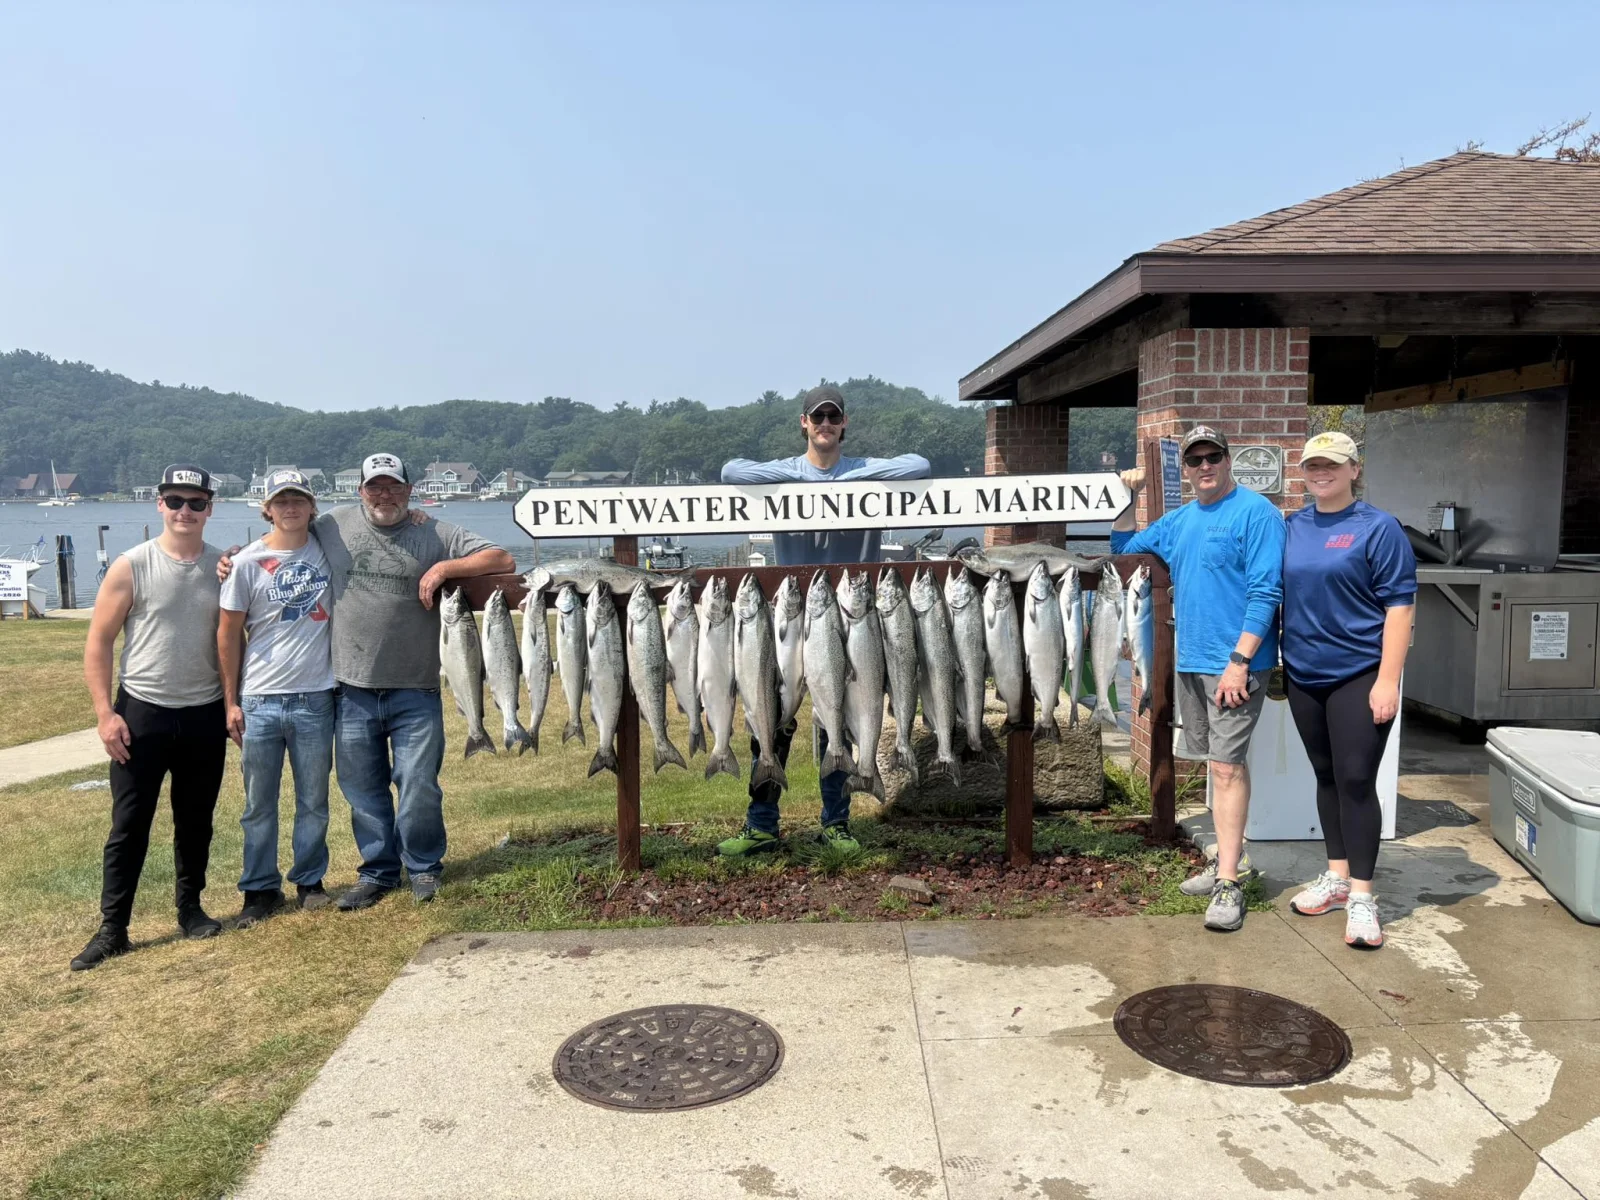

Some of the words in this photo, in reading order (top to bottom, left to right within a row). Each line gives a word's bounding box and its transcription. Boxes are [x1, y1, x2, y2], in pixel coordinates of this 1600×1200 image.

[1238, 477, 1270, 485] CMI
[532, 495, 750, 526] PENTWATER
[764, 490, 961, 521] MUNICIPAL
[975, 485, 1116, 514] MARINA
[281, 568, 312, 586] Pabst
[268, 587, 294, 601] Blue
[292, 580, 328, 596] Ribbon
